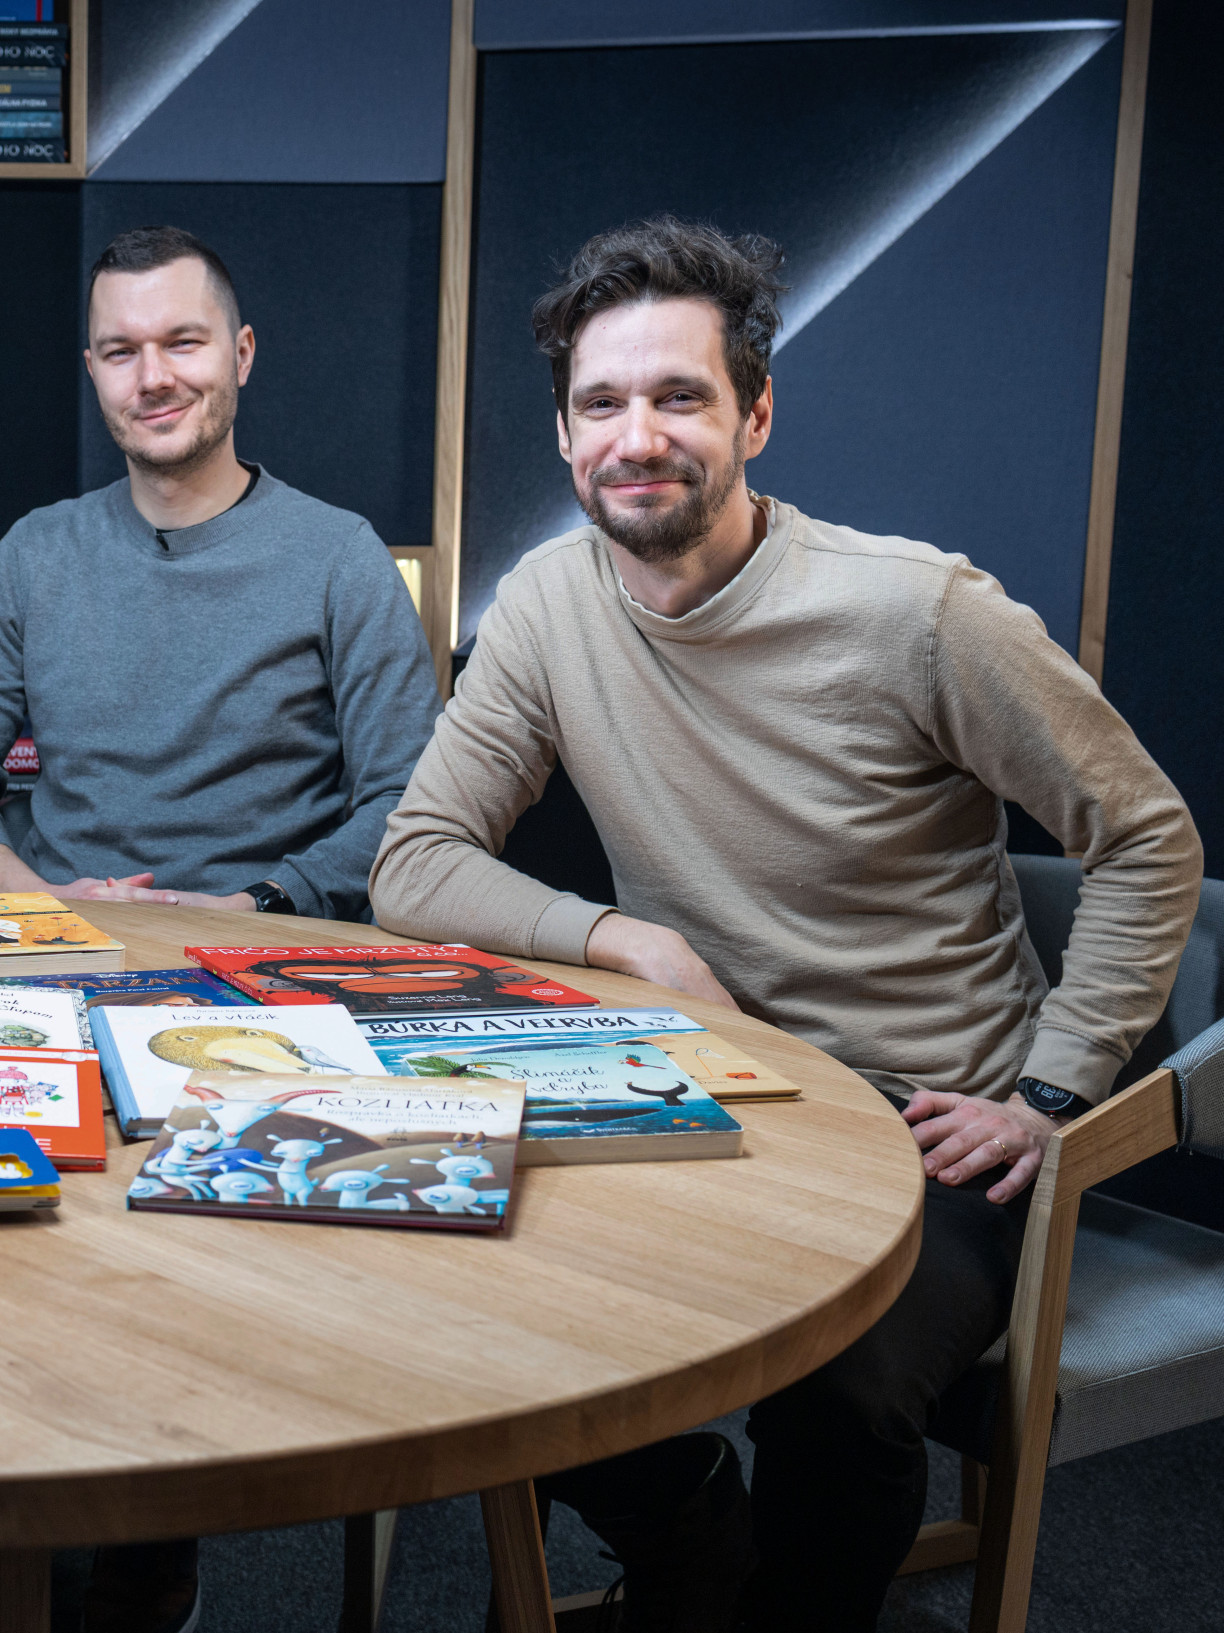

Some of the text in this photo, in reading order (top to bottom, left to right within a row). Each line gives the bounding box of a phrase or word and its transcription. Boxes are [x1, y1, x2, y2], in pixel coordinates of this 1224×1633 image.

[23, 45, 55, 59] NOC
[23, 144, 54, 158] NOC
[201, 946, 290, 955] FRIČO
[298, 947, 333, 955] JE
[43, 974, 204, 990] TARZAN
[96, 972, 138, 980] Disney
[172, 1013, 201, 1021] Lev
[225, 1013, 280, 1021] vtáčik
[368, 1016, 639, 1035] BÚRKA A VEĽRYBA
[510, 1066, 605, 1081] Slimáčik
[530, 1081, 608, 1095] veľryba
[317, 1096, 499, 1112] KOZLIATKA
